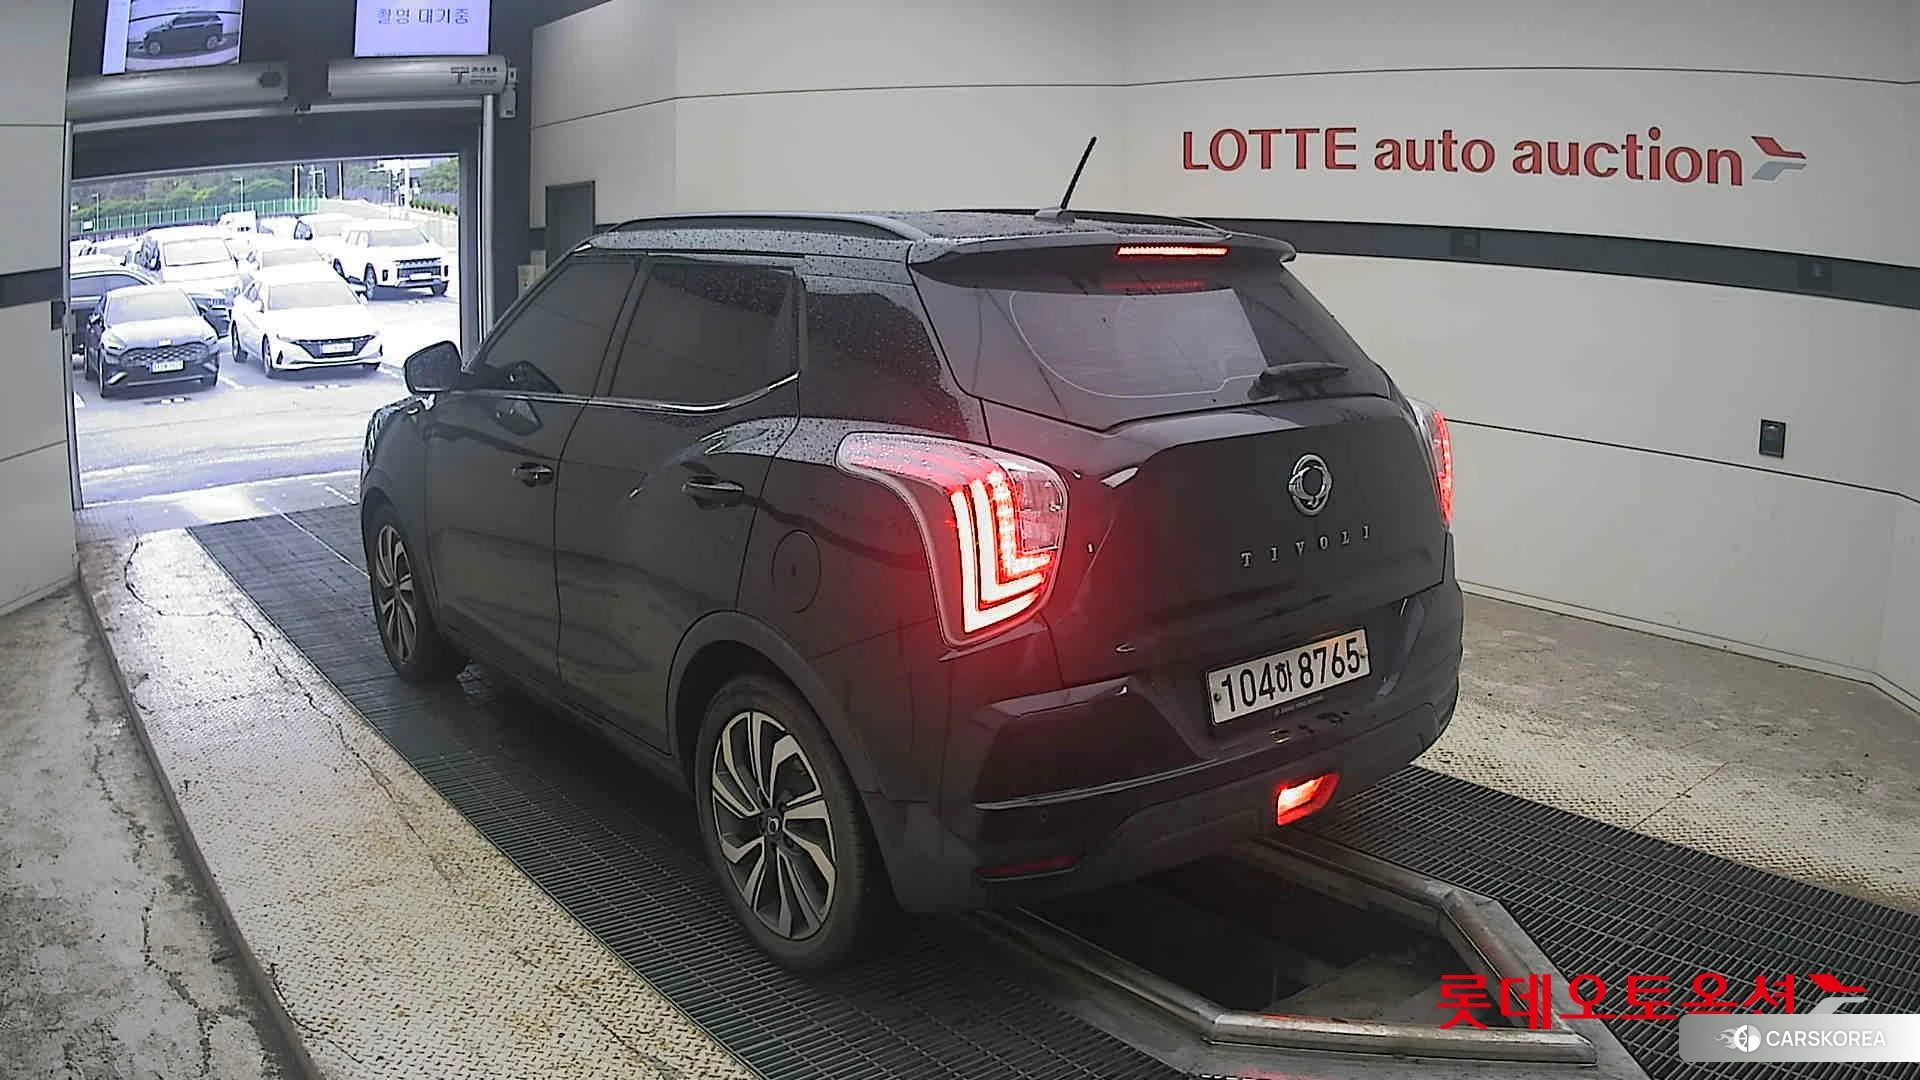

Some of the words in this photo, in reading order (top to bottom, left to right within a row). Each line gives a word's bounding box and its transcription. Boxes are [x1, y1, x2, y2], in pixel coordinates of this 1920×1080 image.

[418, 8, 470, 25] 대기중
[1183, 127, 1358, 171] LOTTE
[1374, 131, 1496, 172] auto
[1512, 127, 1744, 187] auction
[1240, 525, 1370, 568] TIVOLI
